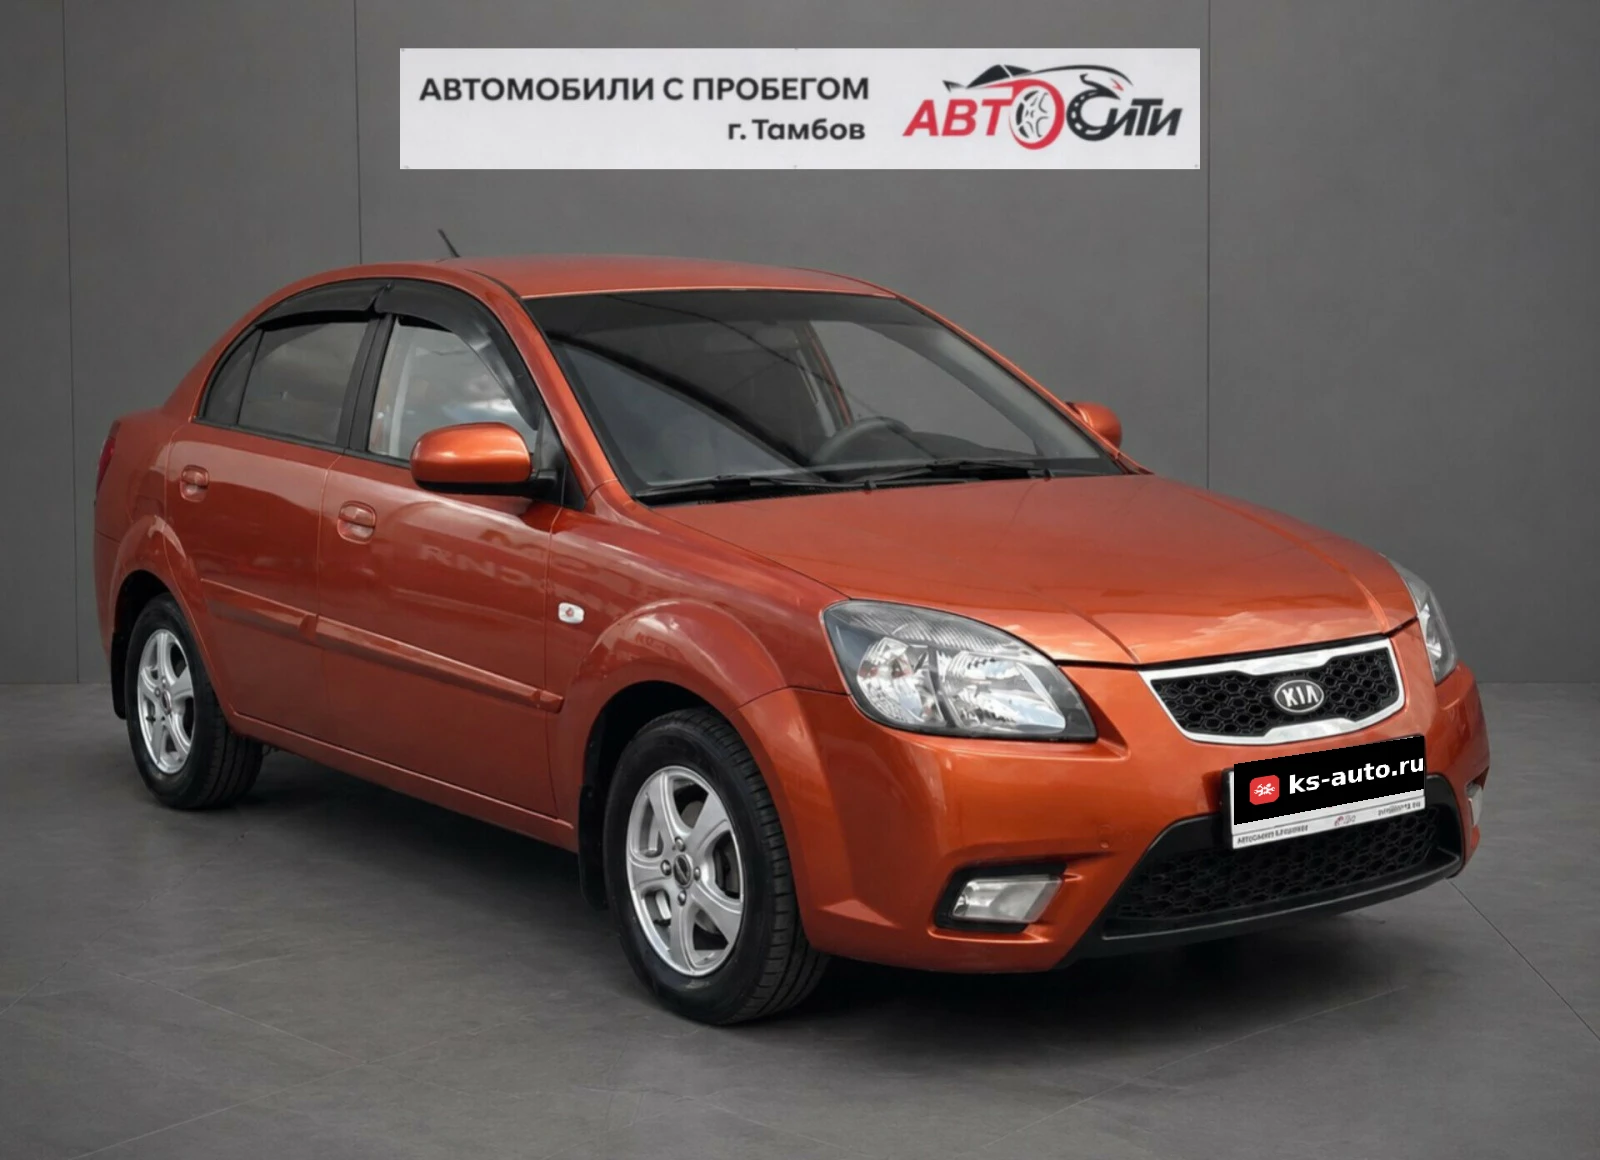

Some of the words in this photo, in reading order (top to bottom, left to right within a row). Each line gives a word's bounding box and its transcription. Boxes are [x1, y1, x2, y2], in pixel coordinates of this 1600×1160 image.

[419, 77, 654, 102] АВТОМОБИЛИ
[662, 77, 684, 101] С
[693, 77, 869, 101] ПРОБЕГОМ
[728, 123, 747, 140] г.
[752, 118, 866, 141] Тамбов
[1281, 684, 1319, 708] KIA
